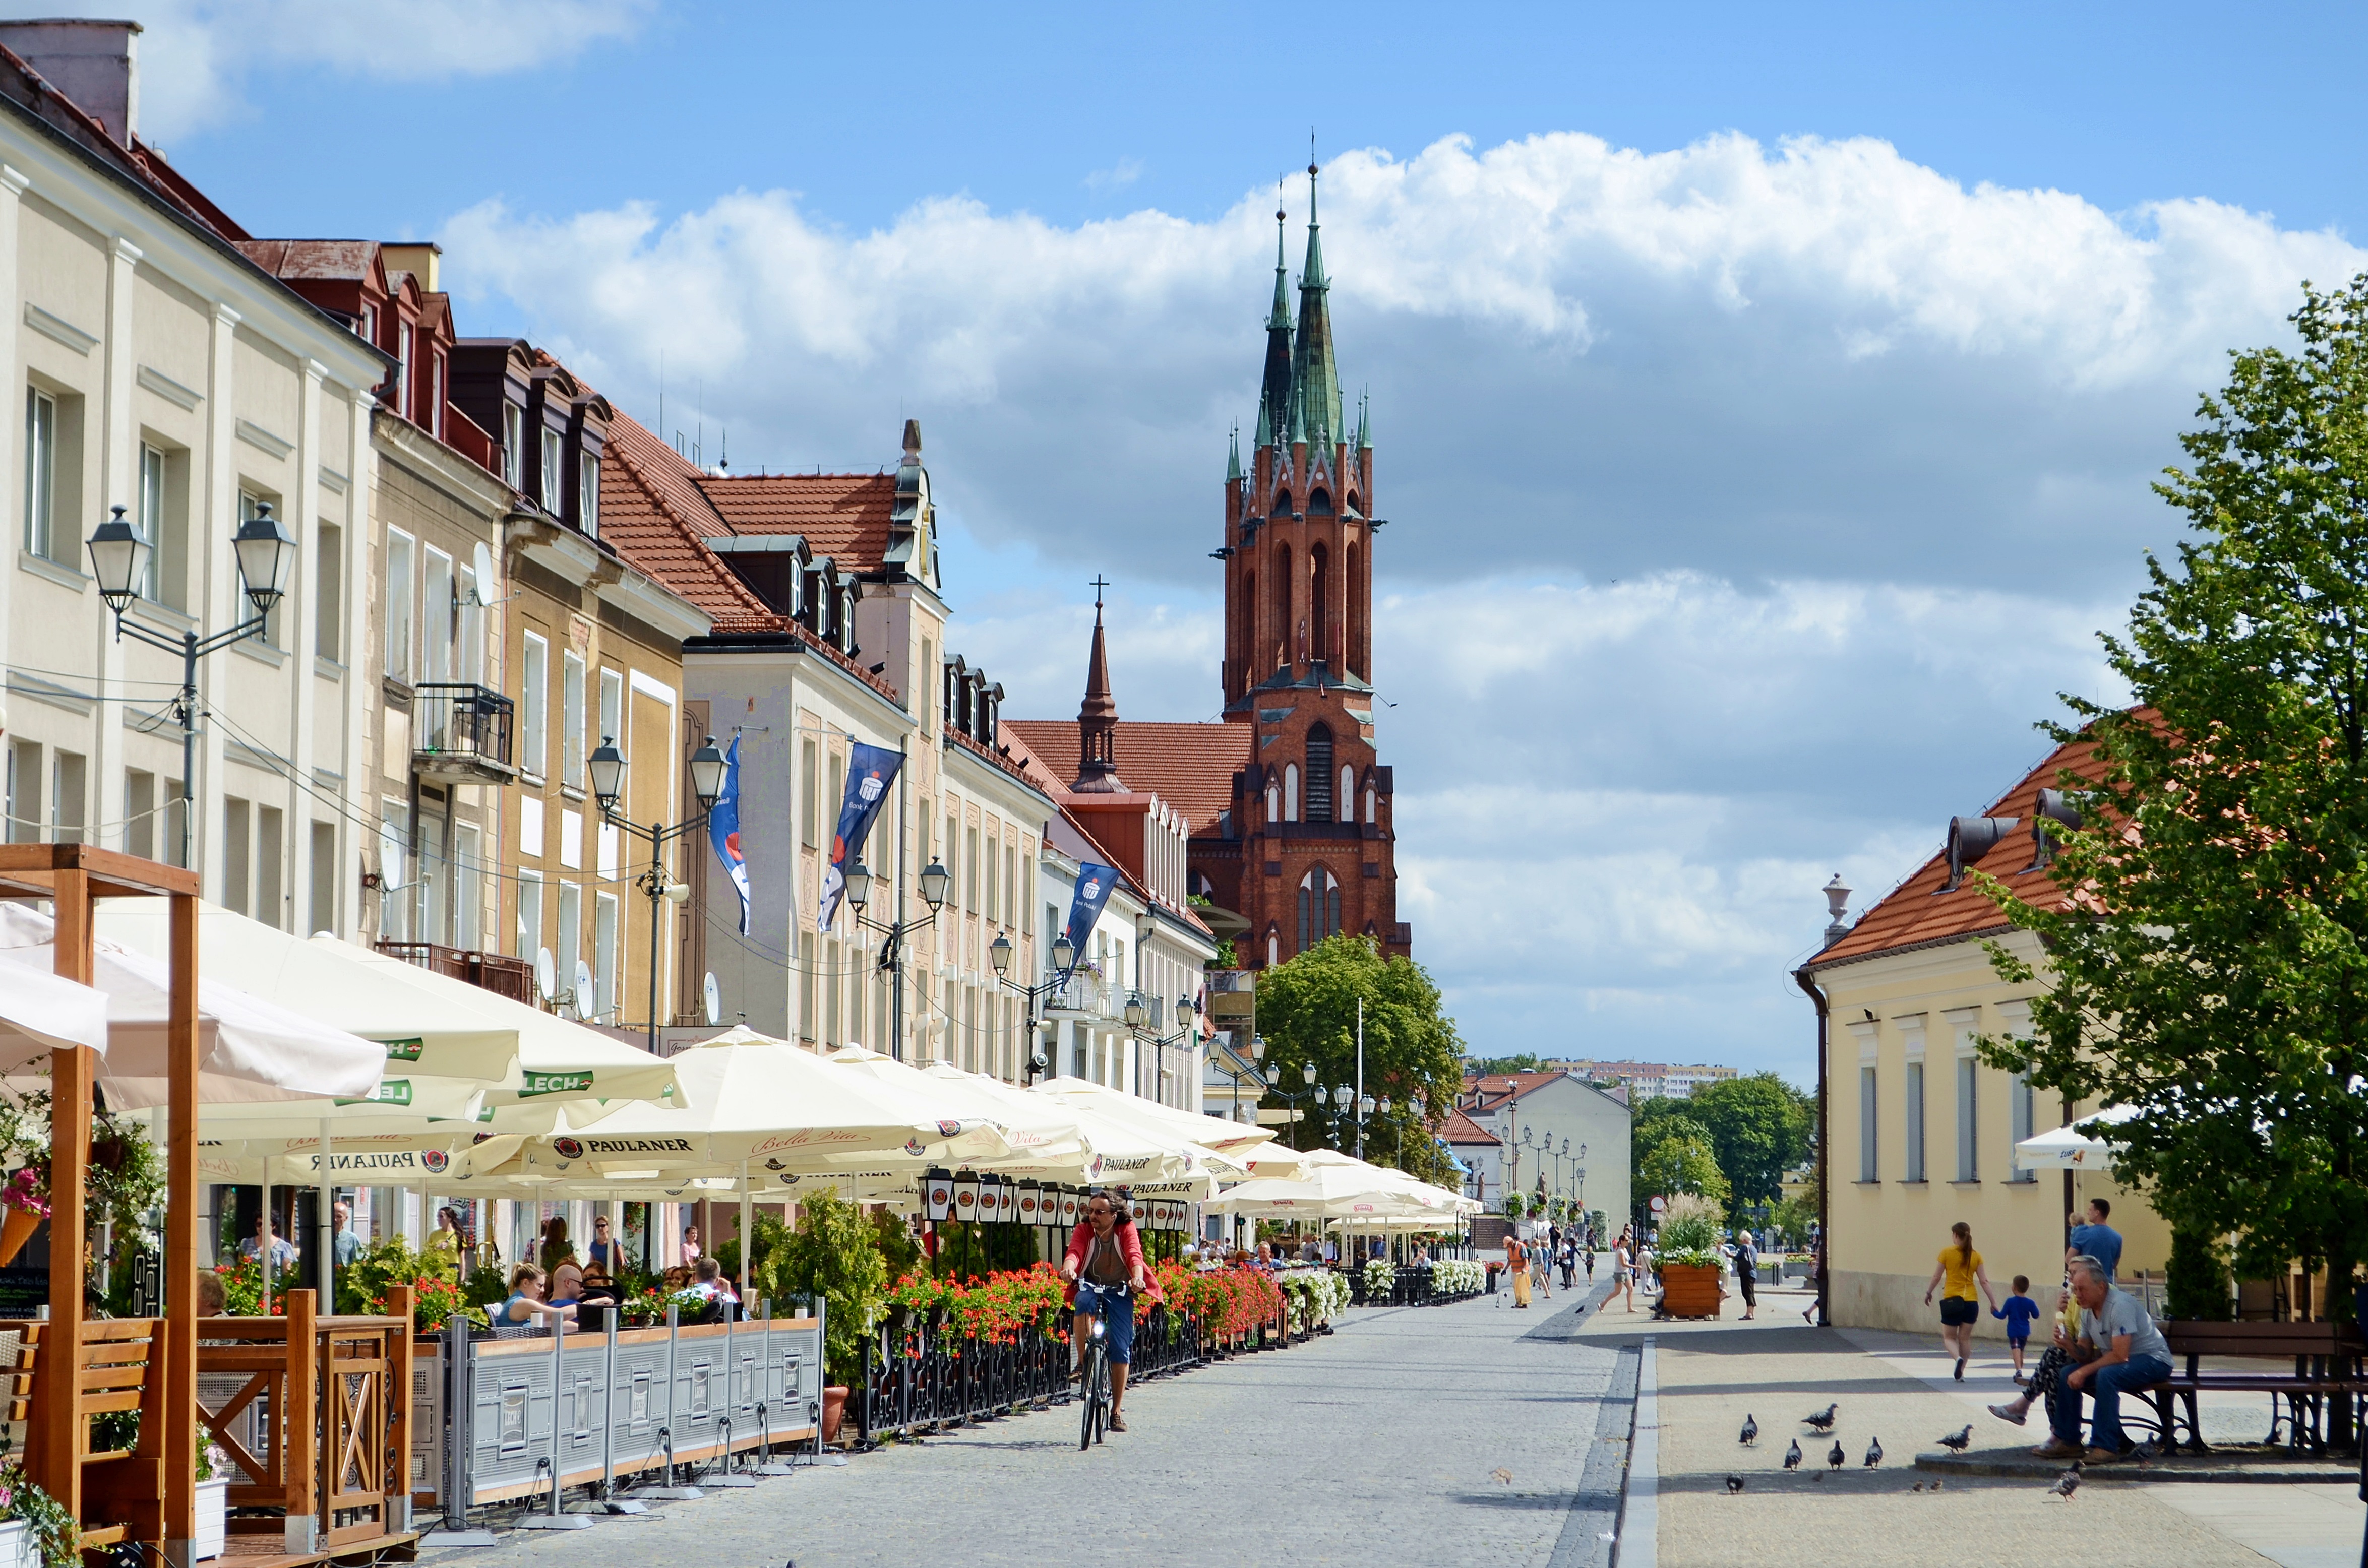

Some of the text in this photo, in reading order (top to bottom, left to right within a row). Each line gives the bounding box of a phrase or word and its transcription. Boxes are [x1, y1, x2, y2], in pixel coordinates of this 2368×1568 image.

[848, 801, 863, 810] Bank
[1084, 902, 1097, 910] Polski
[521, 1077, 578, 1091] LECH
[752, 1127, 858, 1153] Bella Vita
[1010, 1131, 1041, 1146] Vita
[586, 1139, 694, 1152] PAULANER
[1103, 1157, 1150, 1171] PAULANER
[1131, 1182, 1192, 1194] PAULANER
